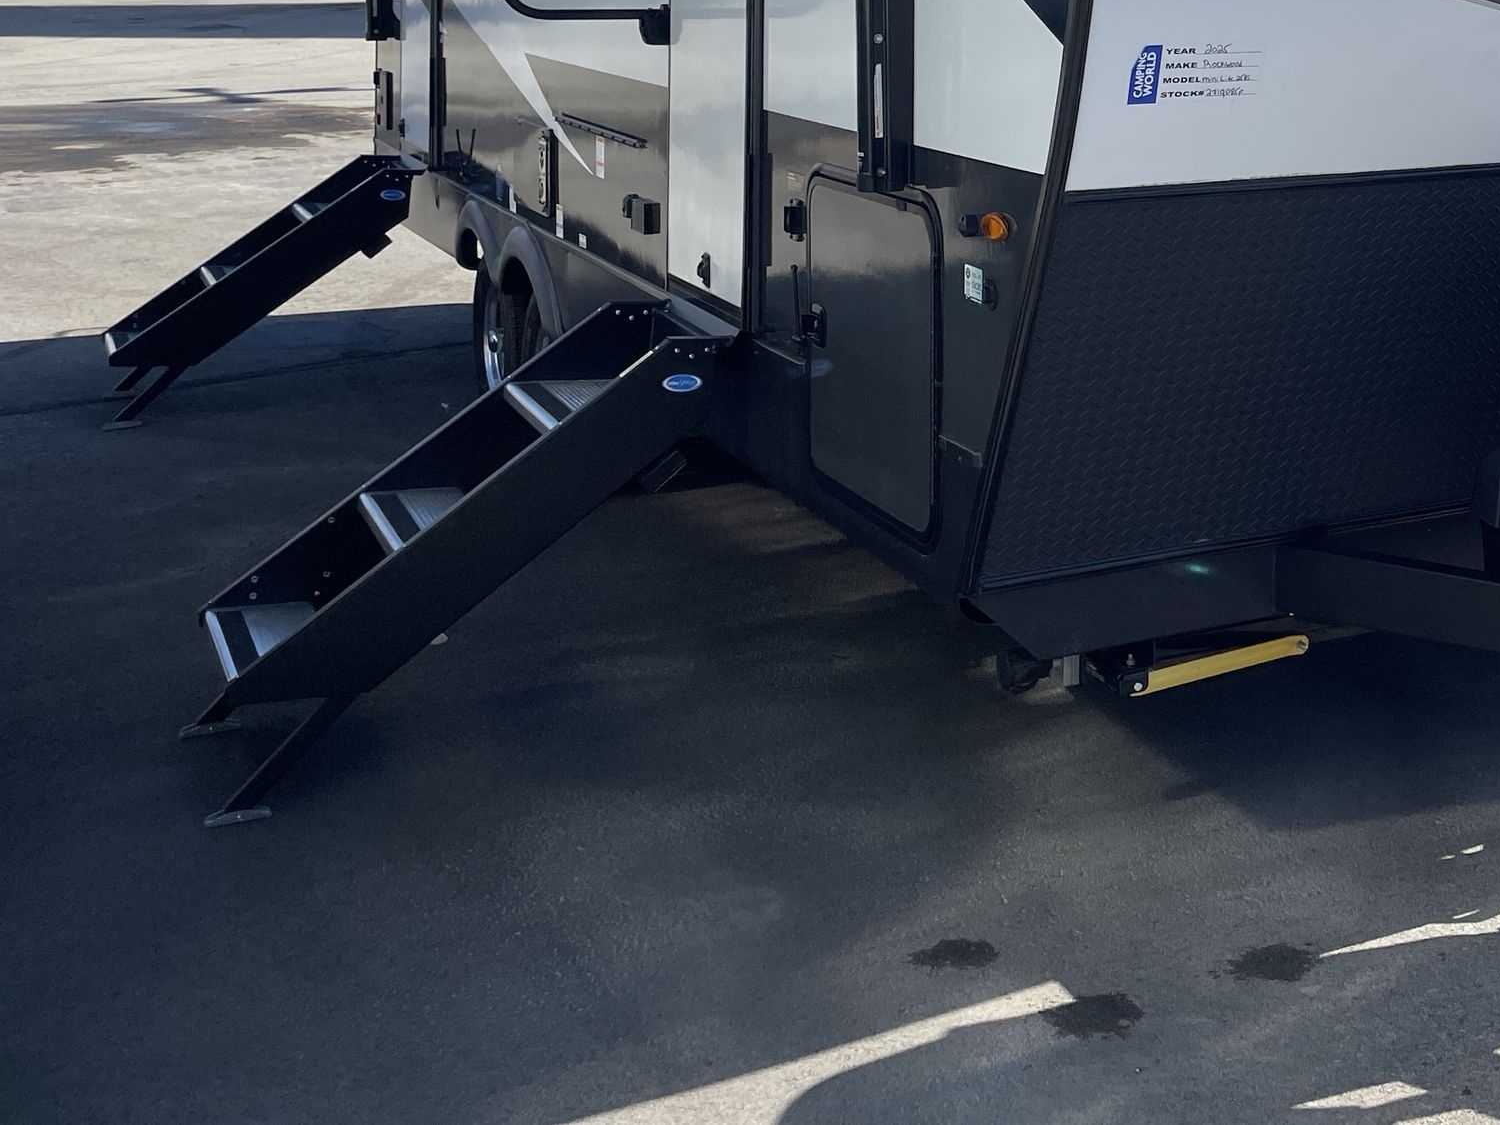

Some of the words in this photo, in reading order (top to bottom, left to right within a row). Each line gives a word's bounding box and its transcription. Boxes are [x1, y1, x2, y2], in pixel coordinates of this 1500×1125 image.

[1204, 43, 1232, 54] 2025
[1133, 52, 1147, 98] CAMPING
[1142, 52, 1157, 97] WORLD
